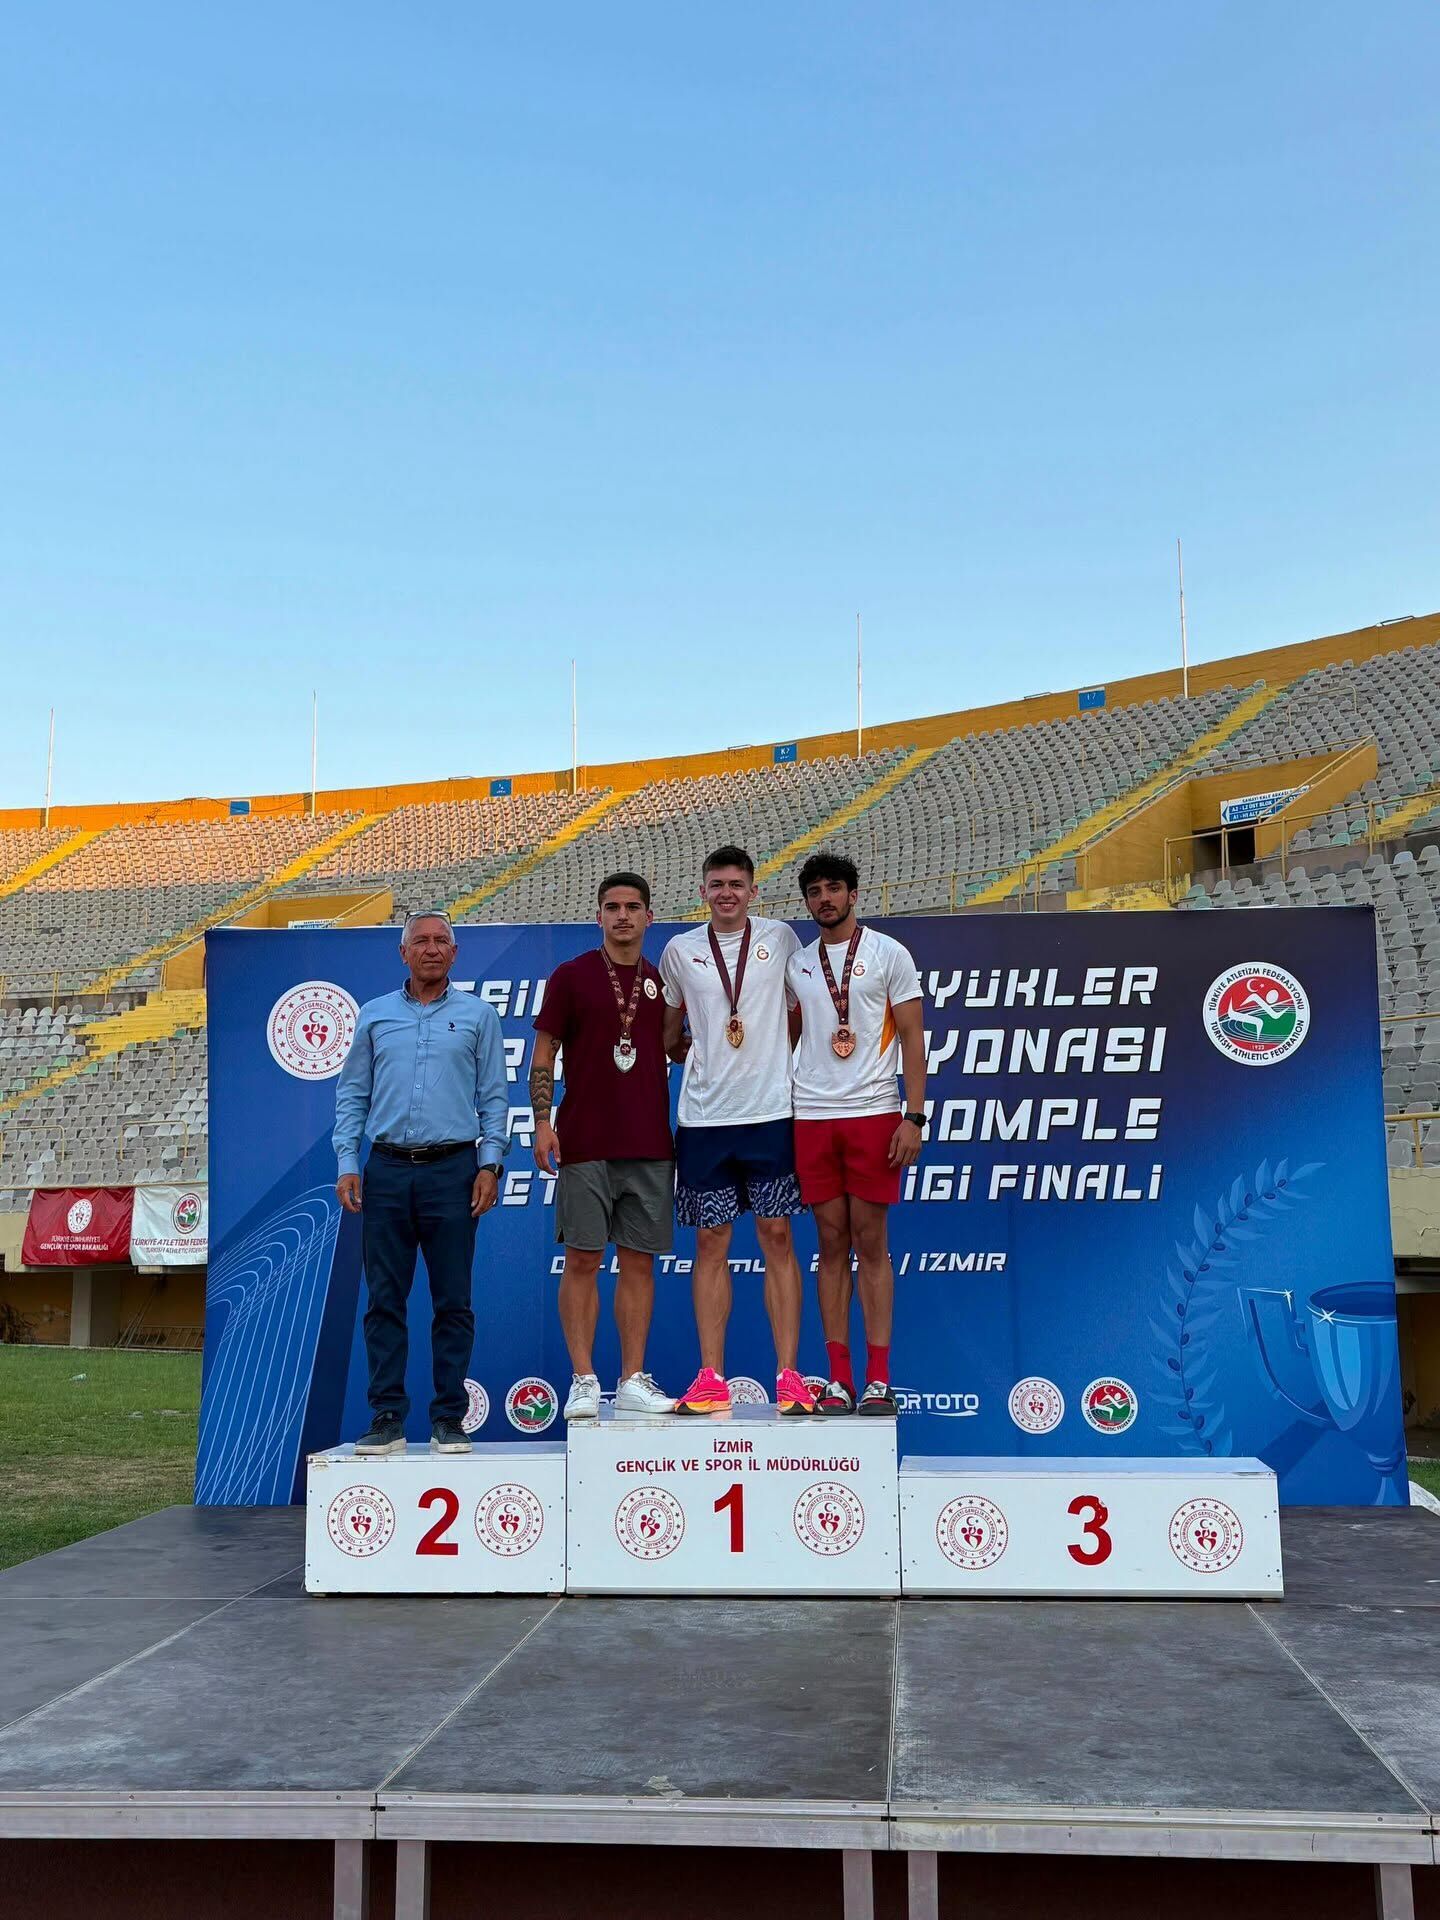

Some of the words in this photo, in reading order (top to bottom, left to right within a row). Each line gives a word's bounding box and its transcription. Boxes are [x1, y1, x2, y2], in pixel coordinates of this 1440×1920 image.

[918, 967, 1158, 1008] YÜKLER
[1209, 981, 1227, 1011] TÜRKİYE
[1226, 968, 1260, 985] ATLETİZM
[1262, 968, 1304, 1010] FEDERASYONU
[288, 1004, 306, 1039] CUMHURİYETİ
[306, 1002, 331, 1010] GENÇLİK
[290, 1039, 308, 1056] TÜRKİYE
[322, 1031, 342, 1056] BAKANLIĞI
[924, 1026, 1167, 1074] YONASI
[1211, 1021, 1233, 1050] TURKISH
[1232, 1047, 1269, 1061] ATHLETIC
[1270, 1020, 1304, 1058] FEDERATION
[904, 1165, 972, 1201] İGİ
[988, 1164, 1162, 1200] FİNALİ
[132, 1237, 157, 1246] TÜRKİYE
[157, 1238, 189, 1247] ATLETİZM
[919, 1253, 1006, 1272] İZMİR
[895, 1394, 979, 1410] ORTOTO
[713, 1438, 753, 1453] İZMİR
[616, 1457, 676, 1476] GENÇLİK
[681, 1459, 699, 1472] VE
[705, 1459, 742, 1472] SPOR
[748, 1456, 761, 1472] İL
[766, 1456, 860, 1472] MÜDÜRLÜĞÜ
[415, 1487, 460, 1555] 2
[714, 1483, 744, 1553] 1
[1067, 1495, 1113, 1566] 3
